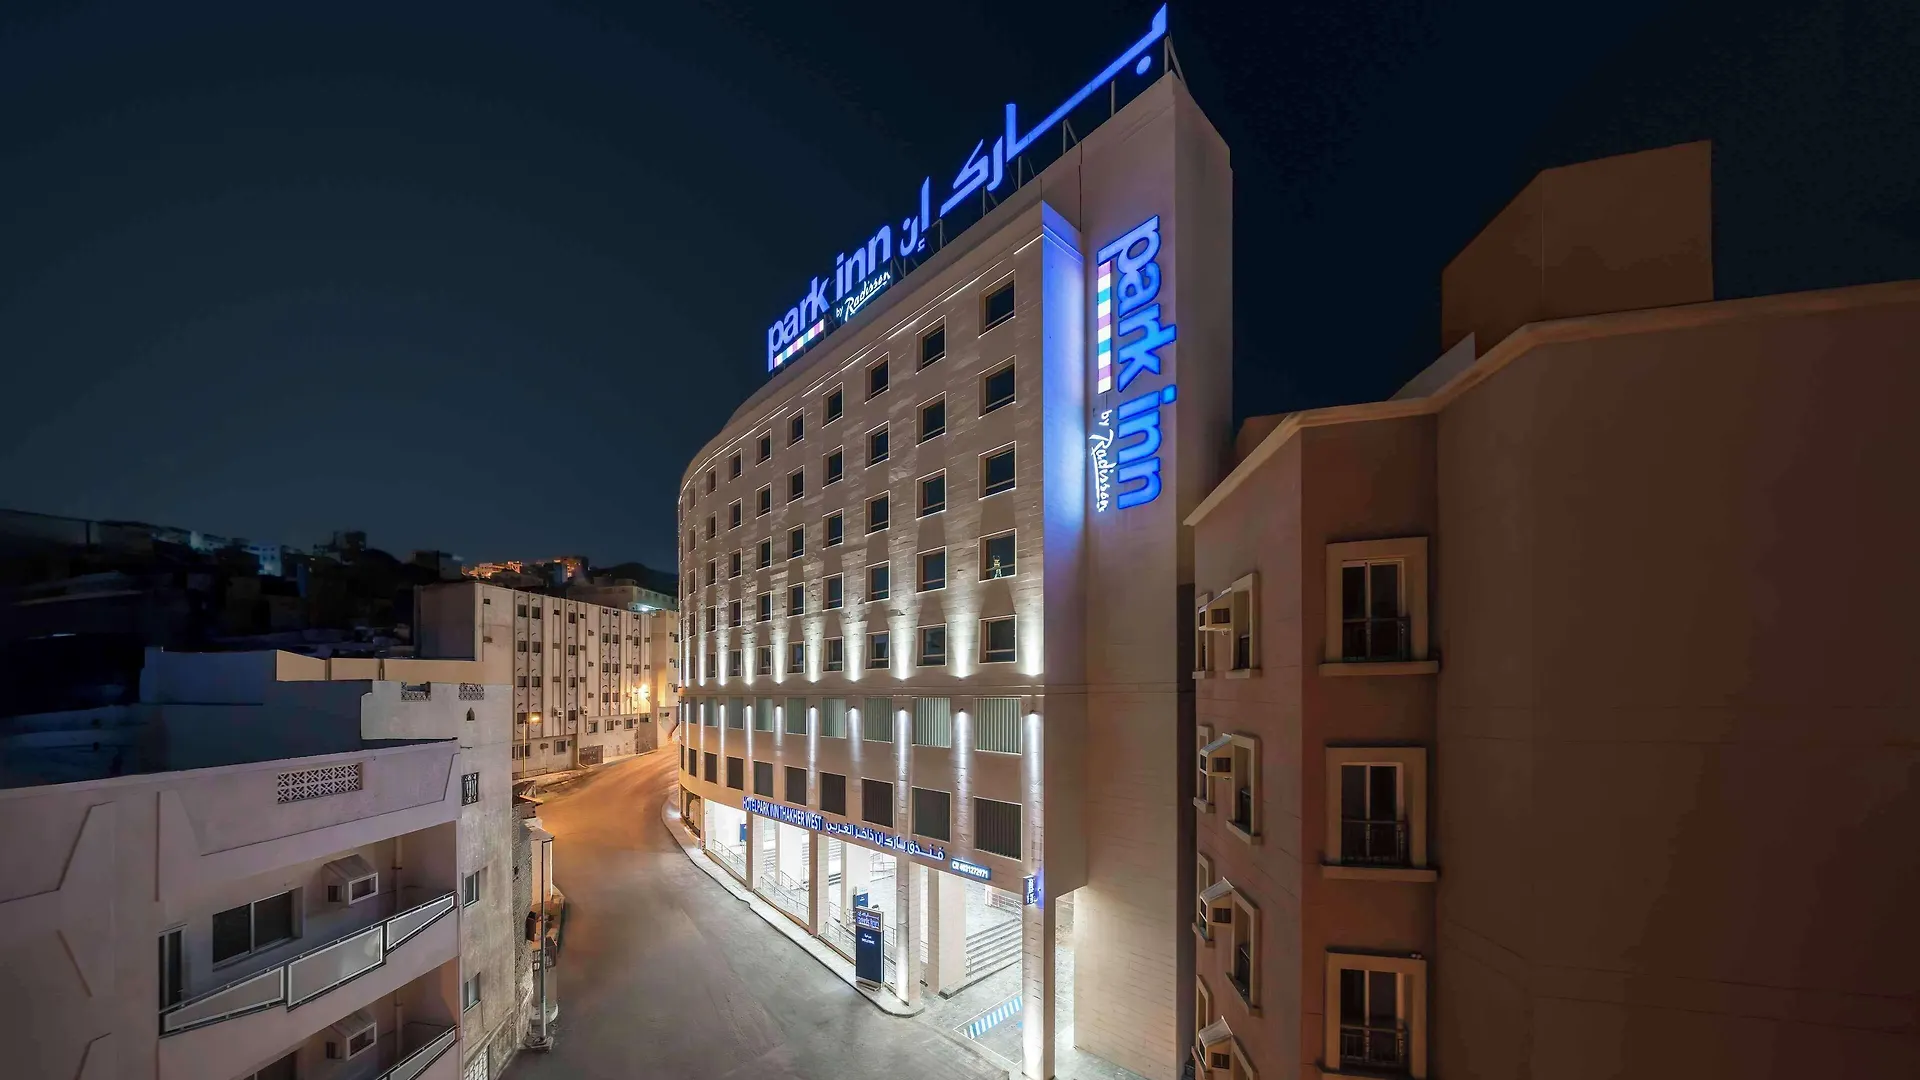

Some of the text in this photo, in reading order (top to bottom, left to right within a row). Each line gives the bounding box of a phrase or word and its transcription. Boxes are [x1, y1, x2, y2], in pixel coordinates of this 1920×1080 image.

[767, 225, 891, 372] park inn
[835, 271, 891, 322] by Radisson
[1097, 214, 1177, 510] park inn
[1089, 409, 1116, 513] by Radisson
[743, 796, 824, 831] HOTEL PARK INN THAKHER WEST
